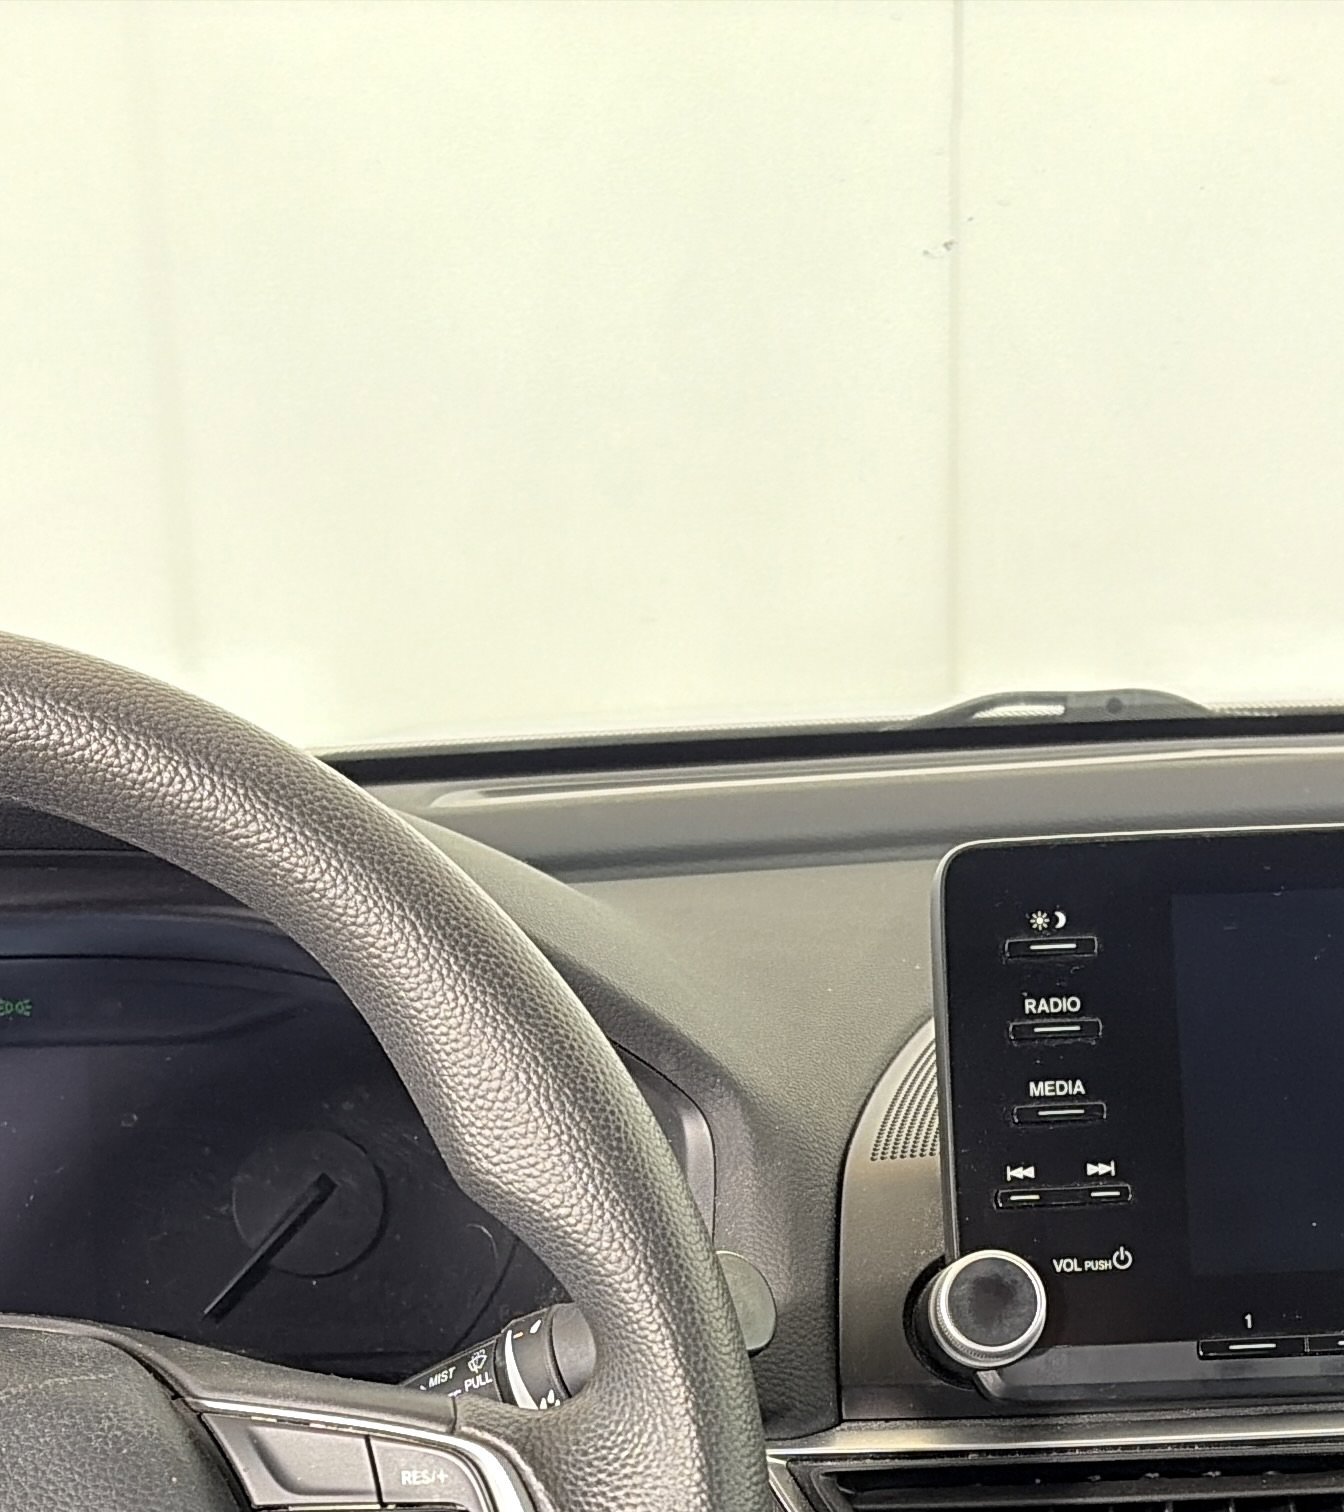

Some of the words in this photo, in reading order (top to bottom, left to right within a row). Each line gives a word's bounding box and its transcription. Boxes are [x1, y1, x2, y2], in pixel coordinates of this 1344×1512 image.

[1024, 996, 1081, 1014] RADIO
[1029, 1079, 1086, 1097] MEDIA
[1053, 1257, 1082, 1274] VOL
[1084, 1259, 1112, 1272] PUSH
[1244, 1313, 1253, 1329] 1
[428, 1366, 456, 1388] MIST
[464, 1372, 493, 1392] PULL
